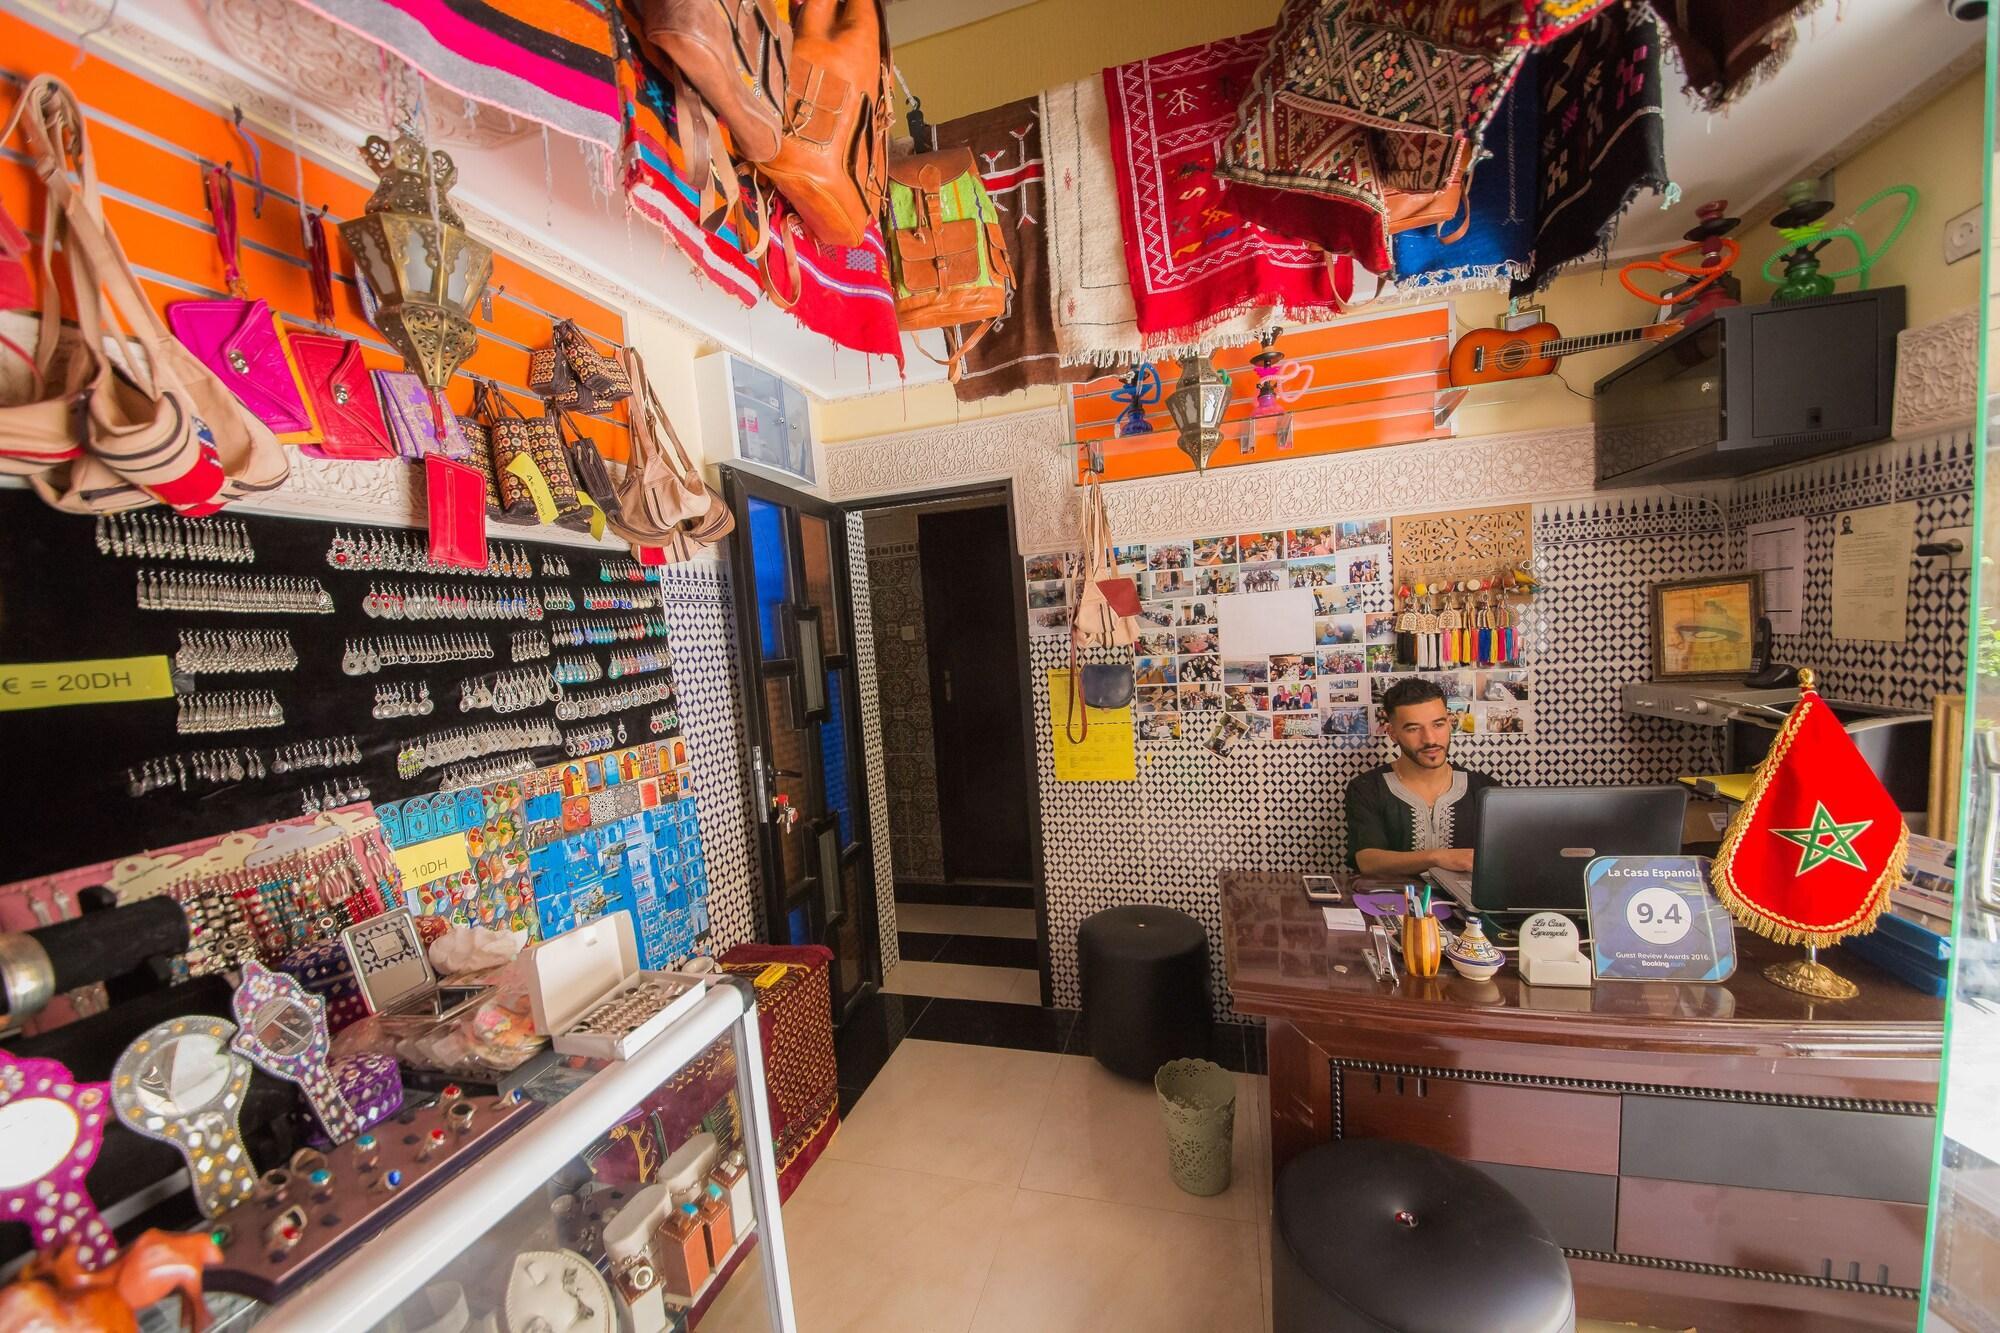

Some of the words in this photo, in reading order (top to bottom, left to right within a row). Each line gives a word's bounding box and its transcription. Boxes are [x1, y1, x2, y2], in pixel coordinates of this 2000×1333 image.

[31, 680, 48, 689] =
[57, 671, 132, 692] 20DH
[412, 858, 448, 879] 10DH
[1607, 868, 1621, 877] La
[1623, 868, 1649, 877] Casa
[1652, 868, 1702, 879] Espanola
[1636, 902, 1682, 924] 9.4
[1532, 918, 1546, 927] La
[1547, 918, 1567, 928] Casa
[1615, 951, 1636, 959] Guest
[1638, 952, 1662, 960] Review
